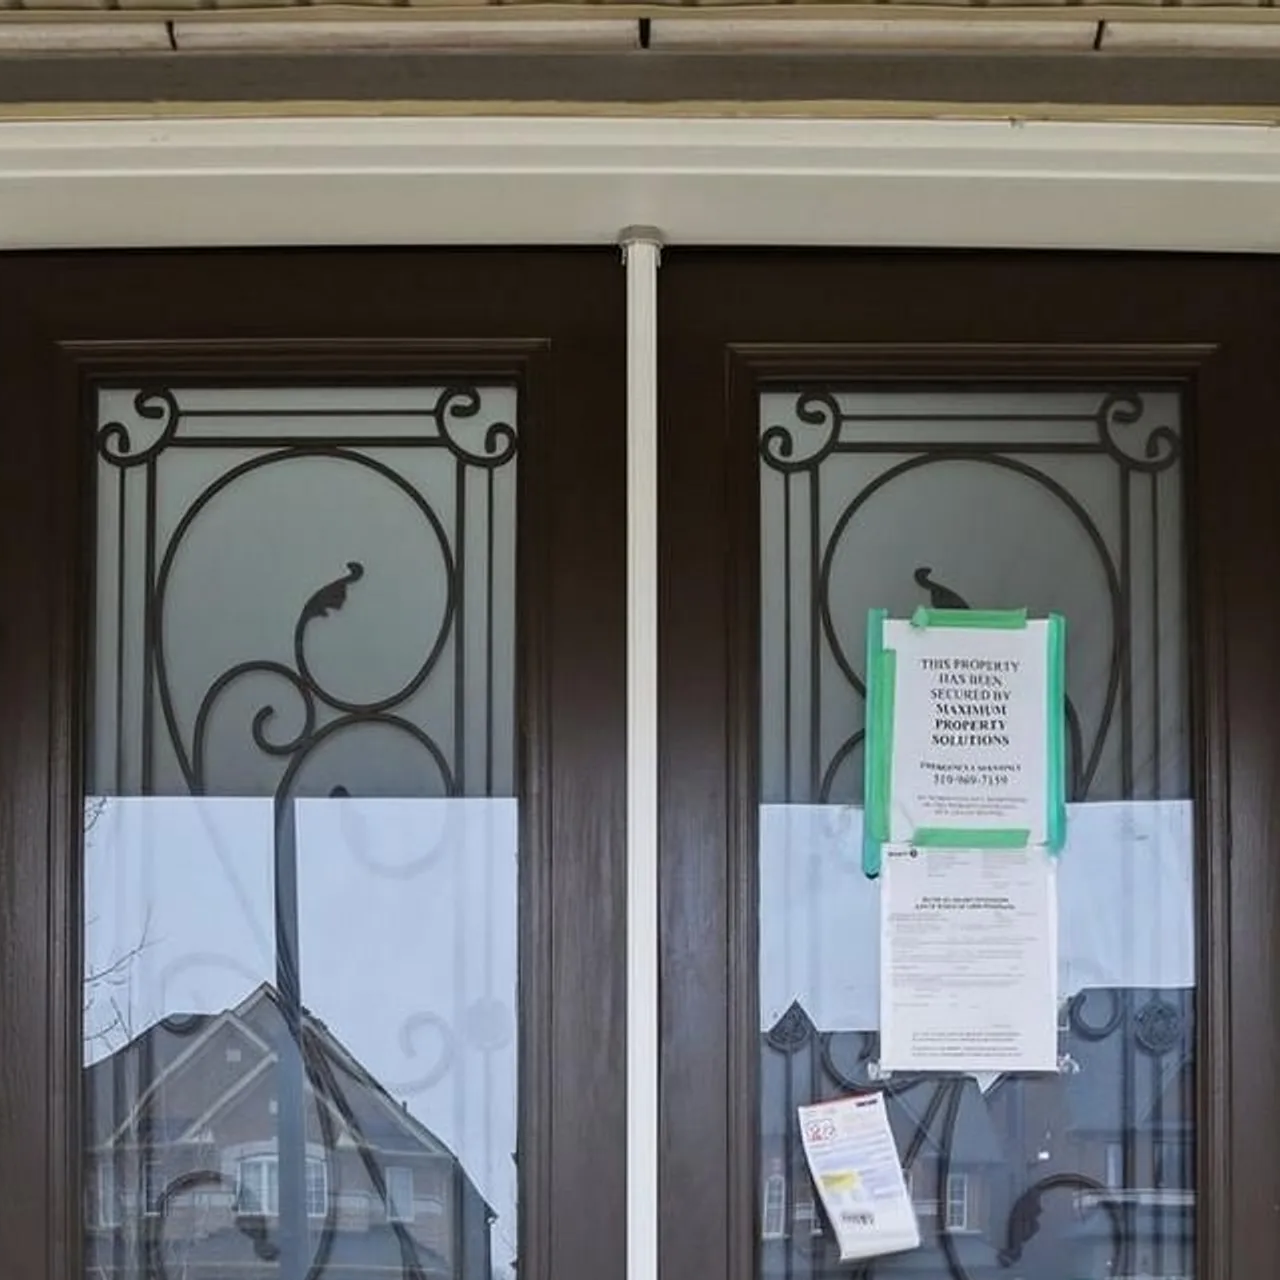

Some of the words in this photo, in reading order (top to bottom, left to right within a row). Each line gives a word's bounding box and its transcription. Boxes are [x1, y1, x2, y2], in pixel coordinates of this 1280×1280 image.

[922, 658, 951, 670] THIS
[954, 659, 1020, 672] PROPERTY
[939, 673, 966, 685] HAS
[969, 674, 1002, 687] BEEN
[930, 688, 991, 700] SECURED
[993, 690, 1012, 701] BY
[936, 703, 1007, 716] MAXIMUM
[934, 718, 1006, 731] PROPERTY
[931, 734, 1010, 746] SOLUTIONS
